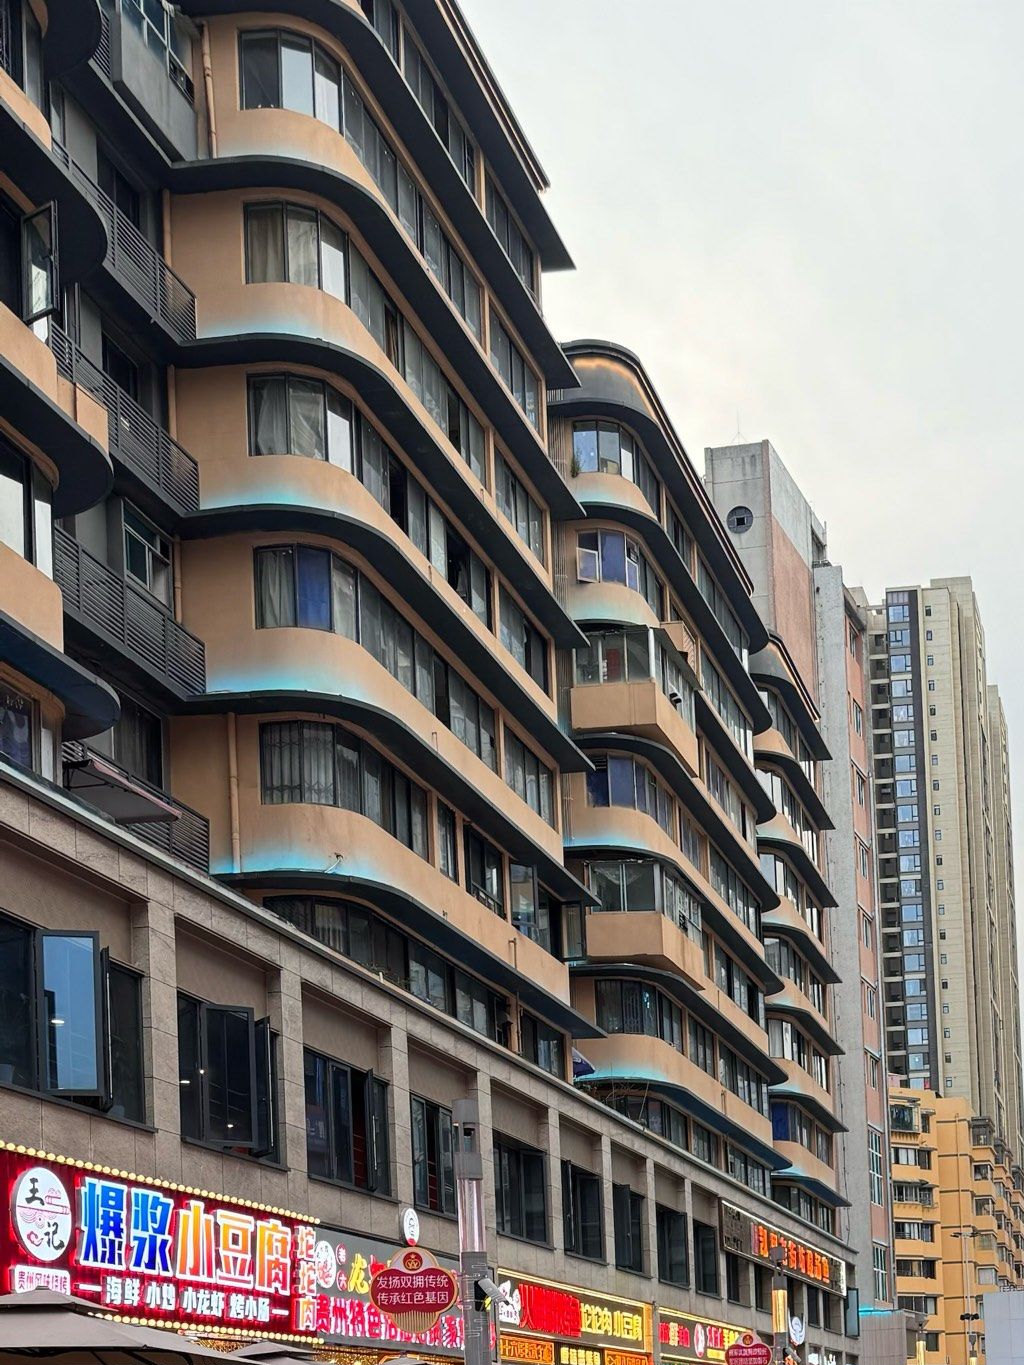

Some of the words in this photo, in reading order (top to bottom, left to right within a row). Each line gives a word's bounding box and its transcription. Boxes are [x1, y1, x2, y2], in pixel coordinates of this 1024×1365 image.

[25, 1177, 66, 1251] 王记
[80, 1177, 291, 1295] 爆浆小豆腐
[106, 1276, 140, 1306] 海鲜
[183, 1286, 225, 1317] 小龙虾
[297, 1226, 316, 1331] 坨坨肉
[377, 1274, 449, 1289] 发扬双拥传统
[377, 1291, 449, 1305] 传承红色基因
